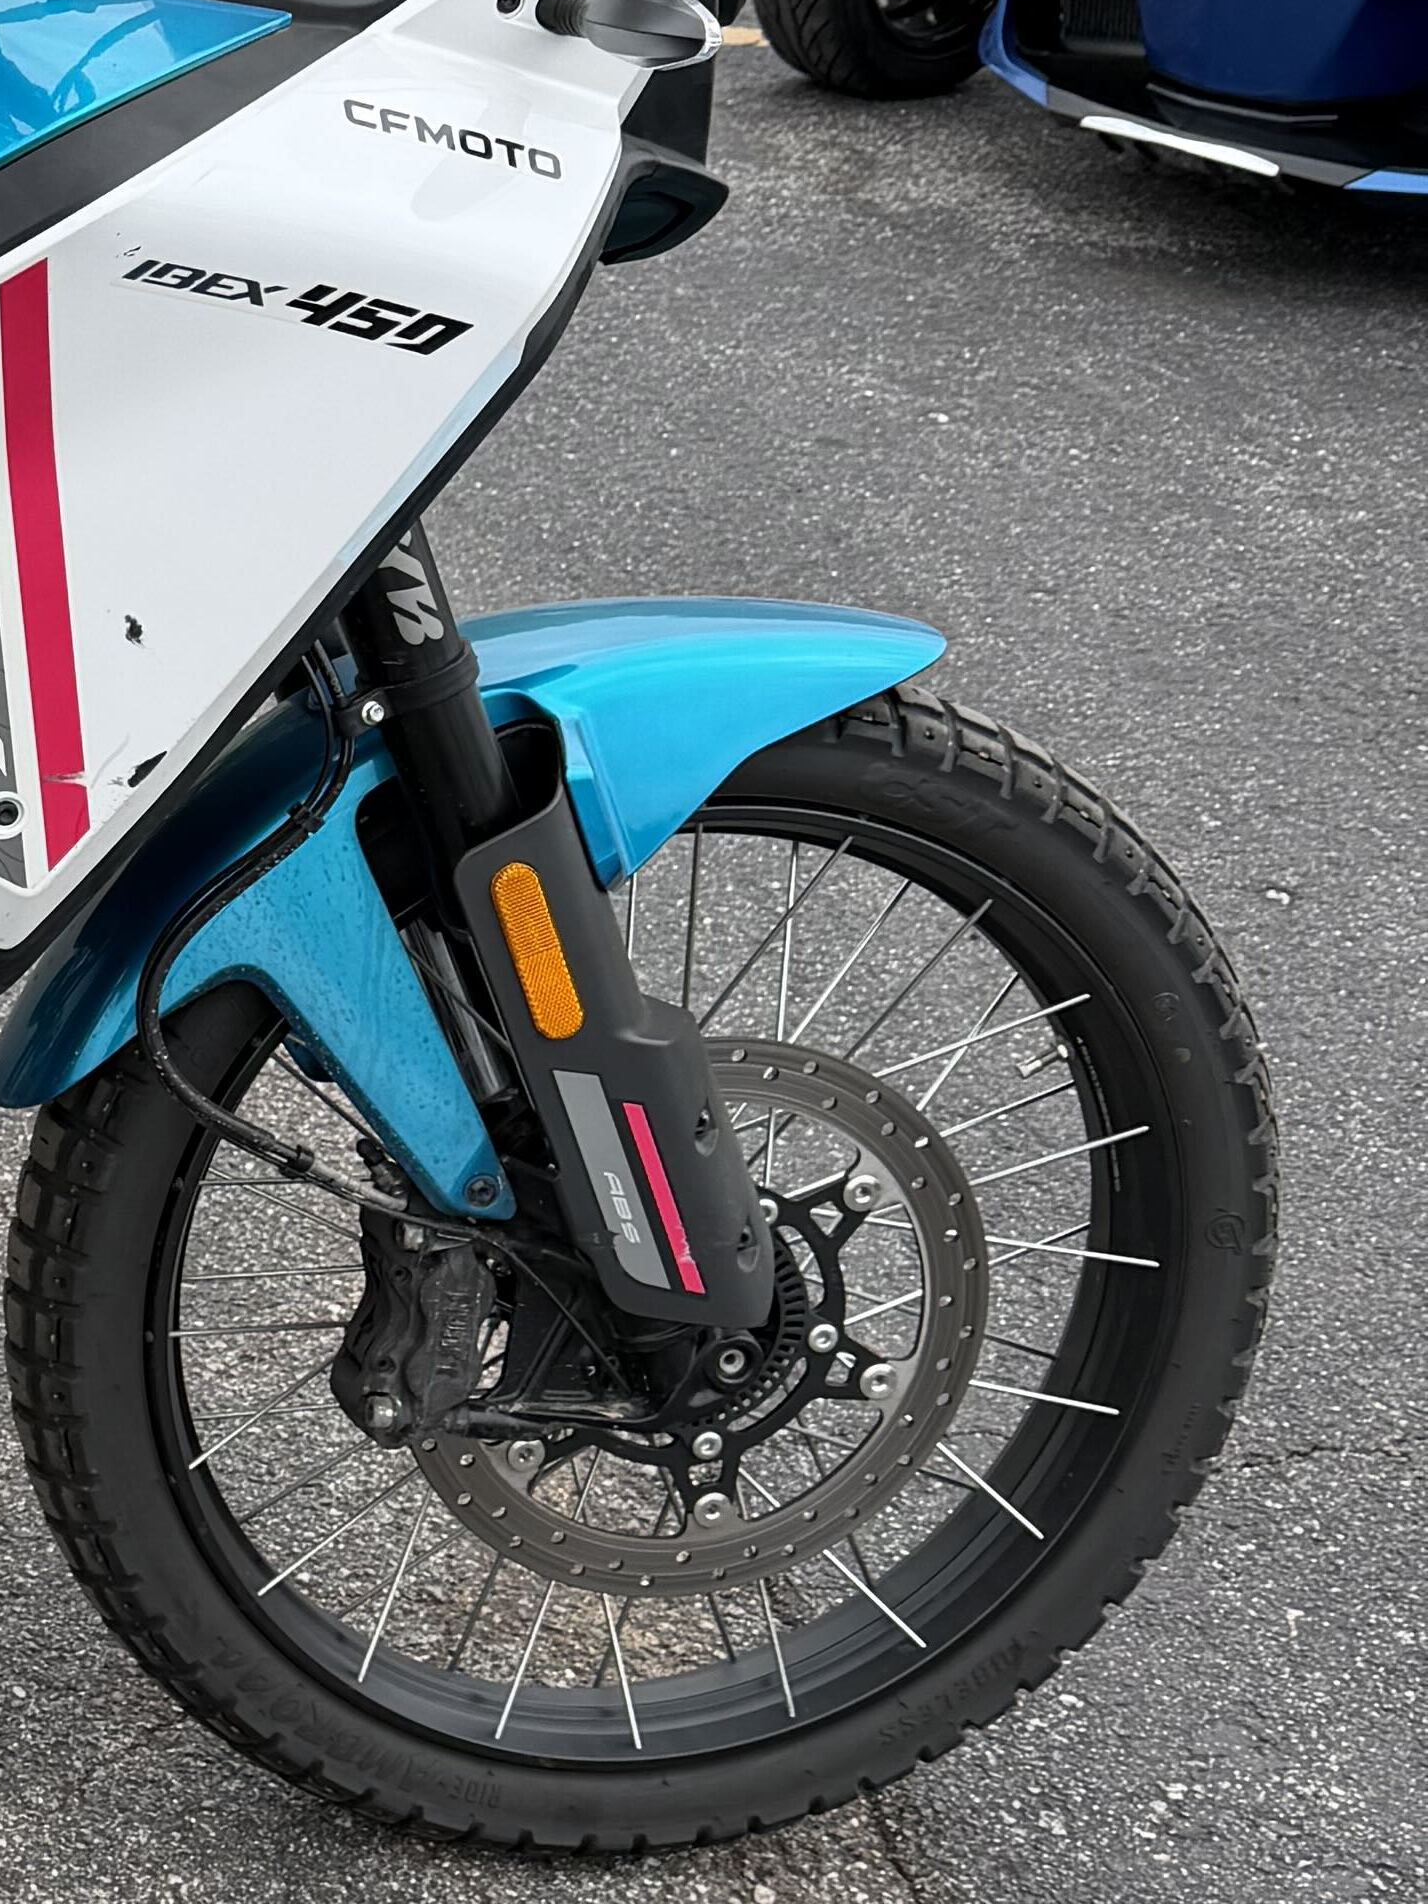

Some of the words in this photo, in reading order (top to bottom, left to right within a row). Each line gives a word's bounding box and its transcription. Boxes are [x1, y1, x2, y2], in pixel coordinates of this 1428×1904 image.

[343, 98, 562, 180] CFMOTO
[121, 258, 289, 307] IBEX
[285, 283, 475, 356] 450
[603, 1171, 642, 1244] ABS
